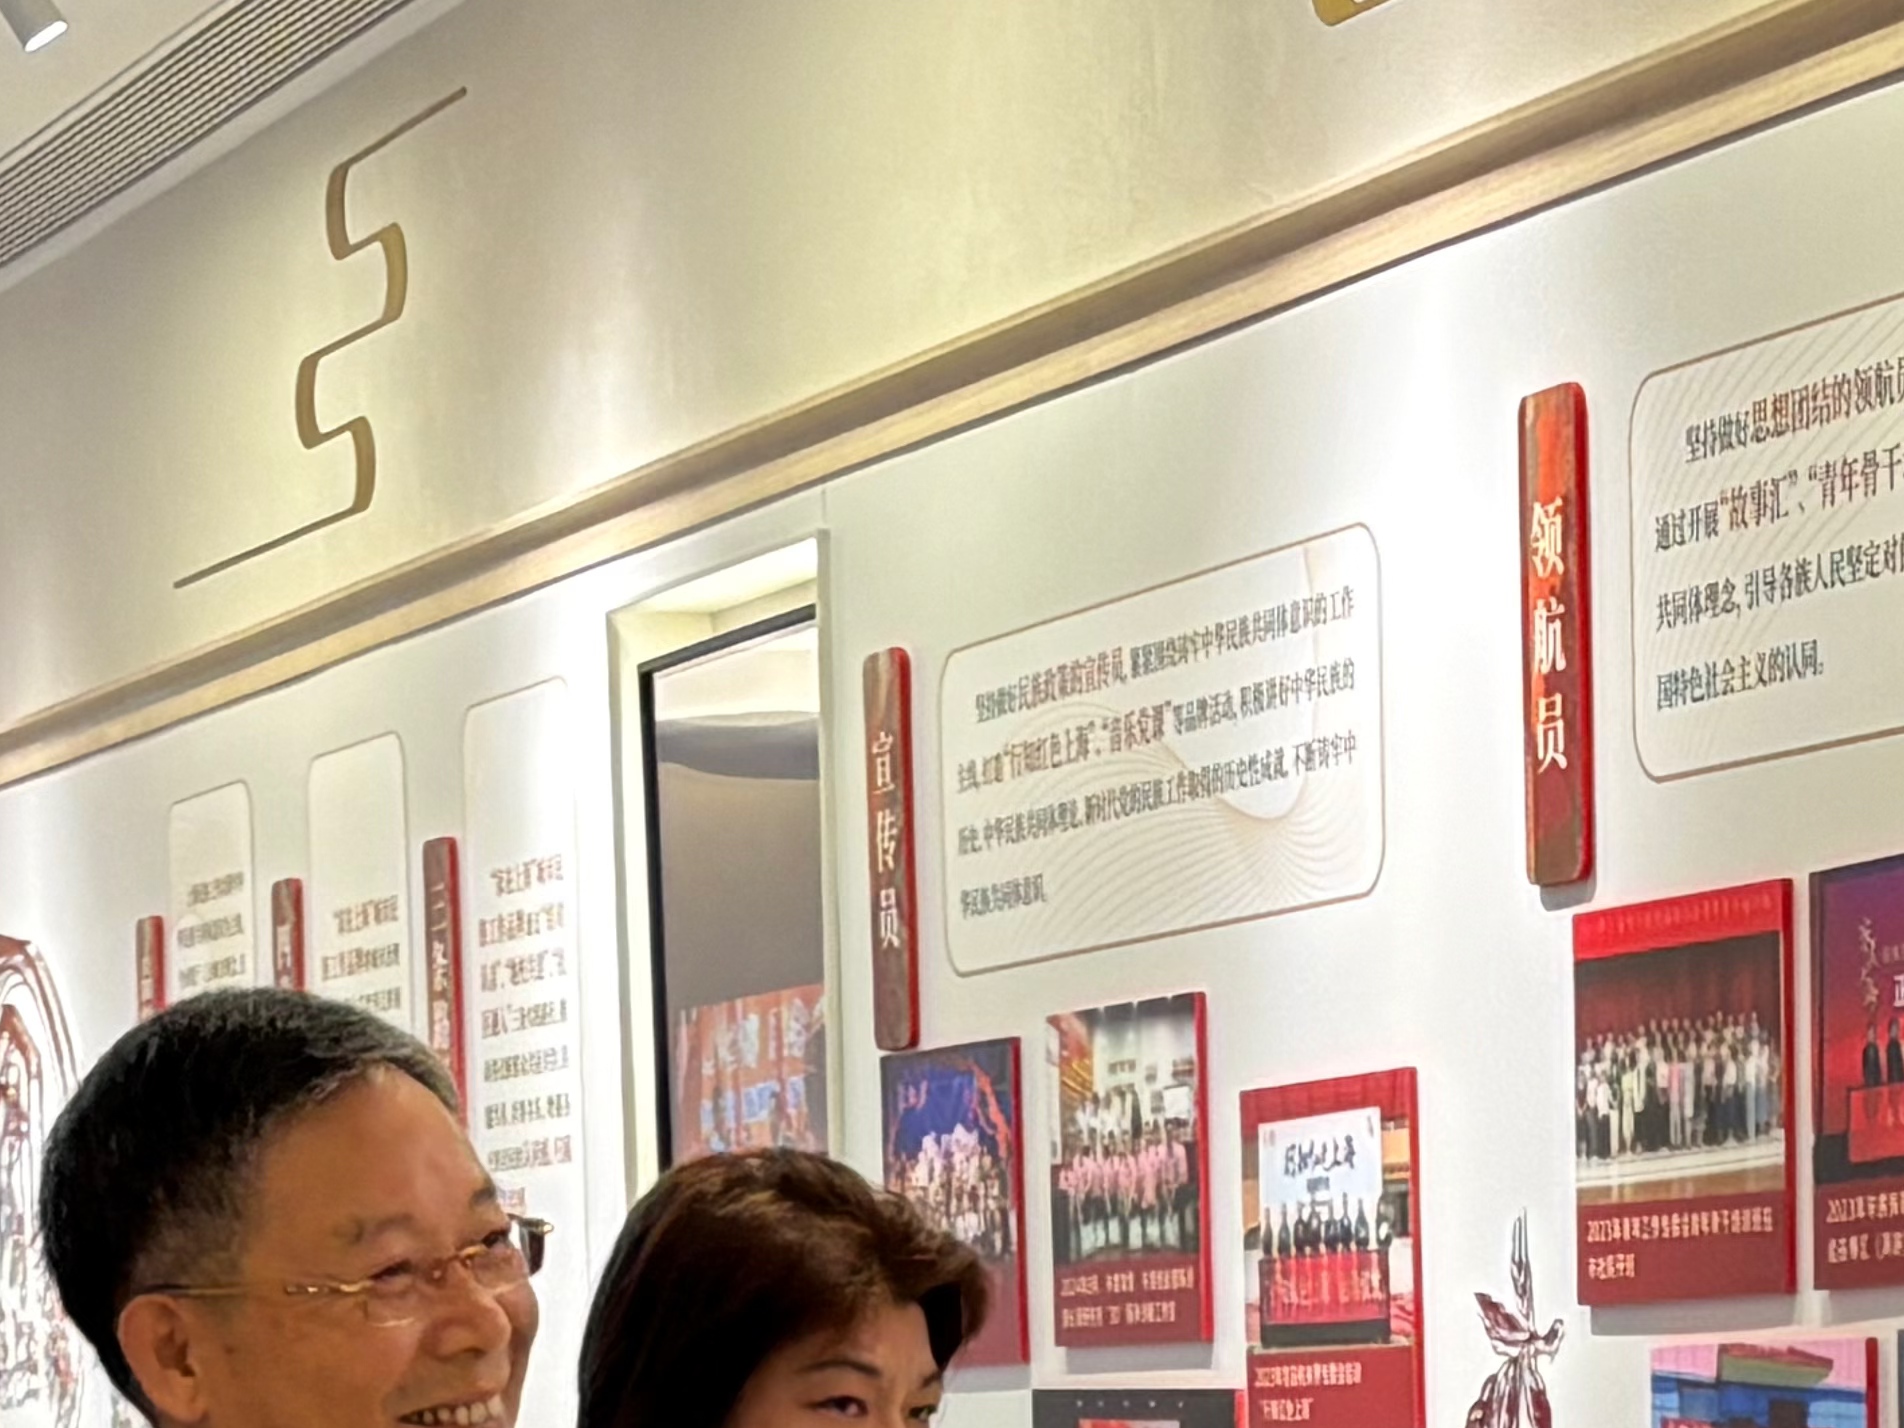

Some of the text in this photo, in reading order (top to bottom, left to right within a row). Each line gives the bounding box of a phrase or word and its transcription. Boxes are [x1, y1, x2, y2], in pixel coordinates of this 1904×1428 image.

[1529, 495, 1568, 776] 领航员
[871, 731, 899, 950] 宣传员
